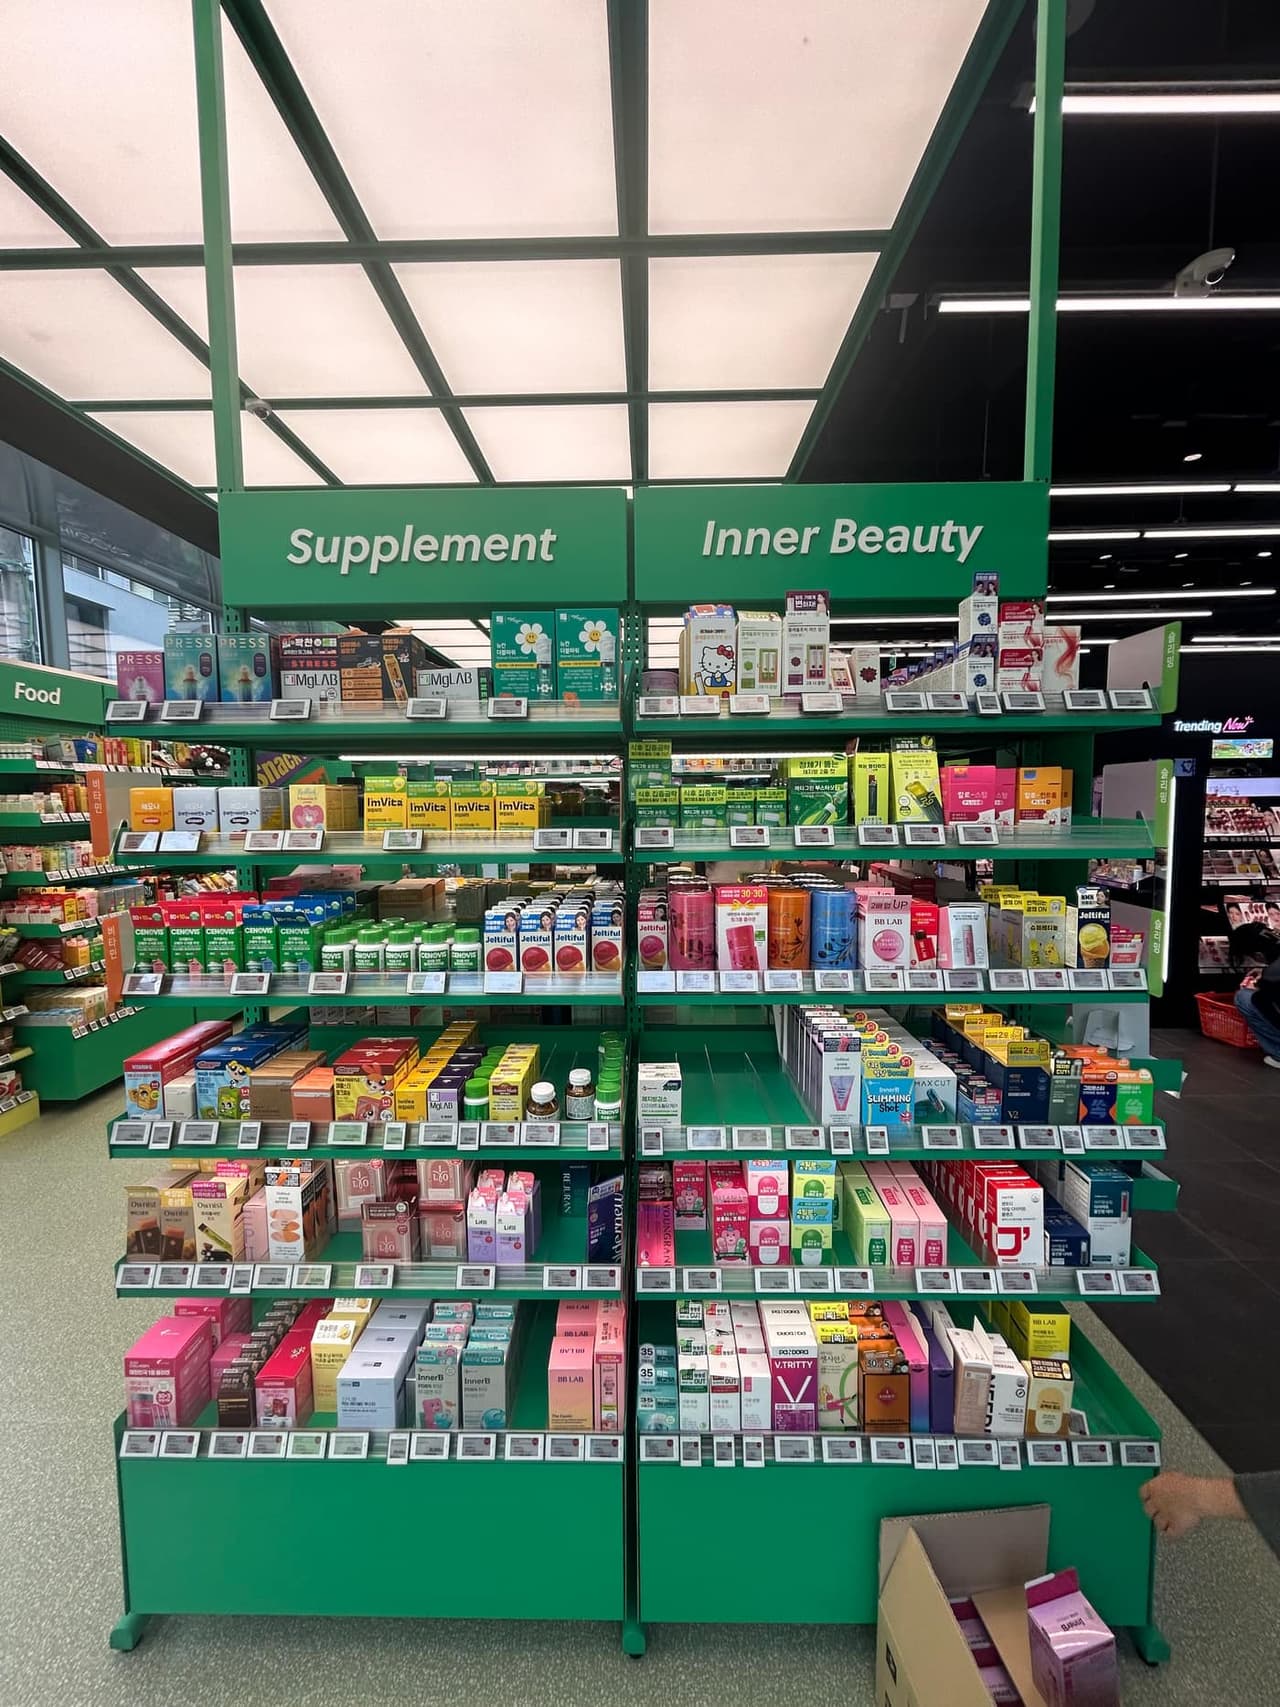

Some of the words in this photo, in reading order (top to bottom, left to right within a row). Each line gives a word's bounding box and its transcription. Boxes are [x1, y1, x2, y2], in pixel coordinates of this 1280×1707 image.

[702, 519, 819, 556] Inner
[830, 518, 984, 564] Beauty
[286, 524, 557, 575] Supplement
[118, 654, 162, 664] PRESS
[296, 673, 338, 689] MgLAB
[14, 681, 61, 705] Food
[1174, 720, 1222, 733] Trending
[1223, 718, 1249, 731] Now
[1079, 911, 1110, 919] Jeltiful
[639, 924, 666, 932] Jeltiful
[521, 934, 551, 943] Jeltiful
[555, 933, 585, 942] Jeltiful
[593, 929, 621, 939] Jeltiful
[486, 935, 515, 944] Jeltiful
[867, 1094, 911, 1104] SLIMMING
[879, 1104, 900, 1113] Shot
[1007, 1110, 1020, 1119] V2
[640, 1347, 653, 1356] 35
[774, 1361, 813, 1369] V.TRITTY
[640, 1368, 654, 1377] 35
[417, 1374, 444, 1382] InnerB
[464, 1377, 491, 1385] InnerB
